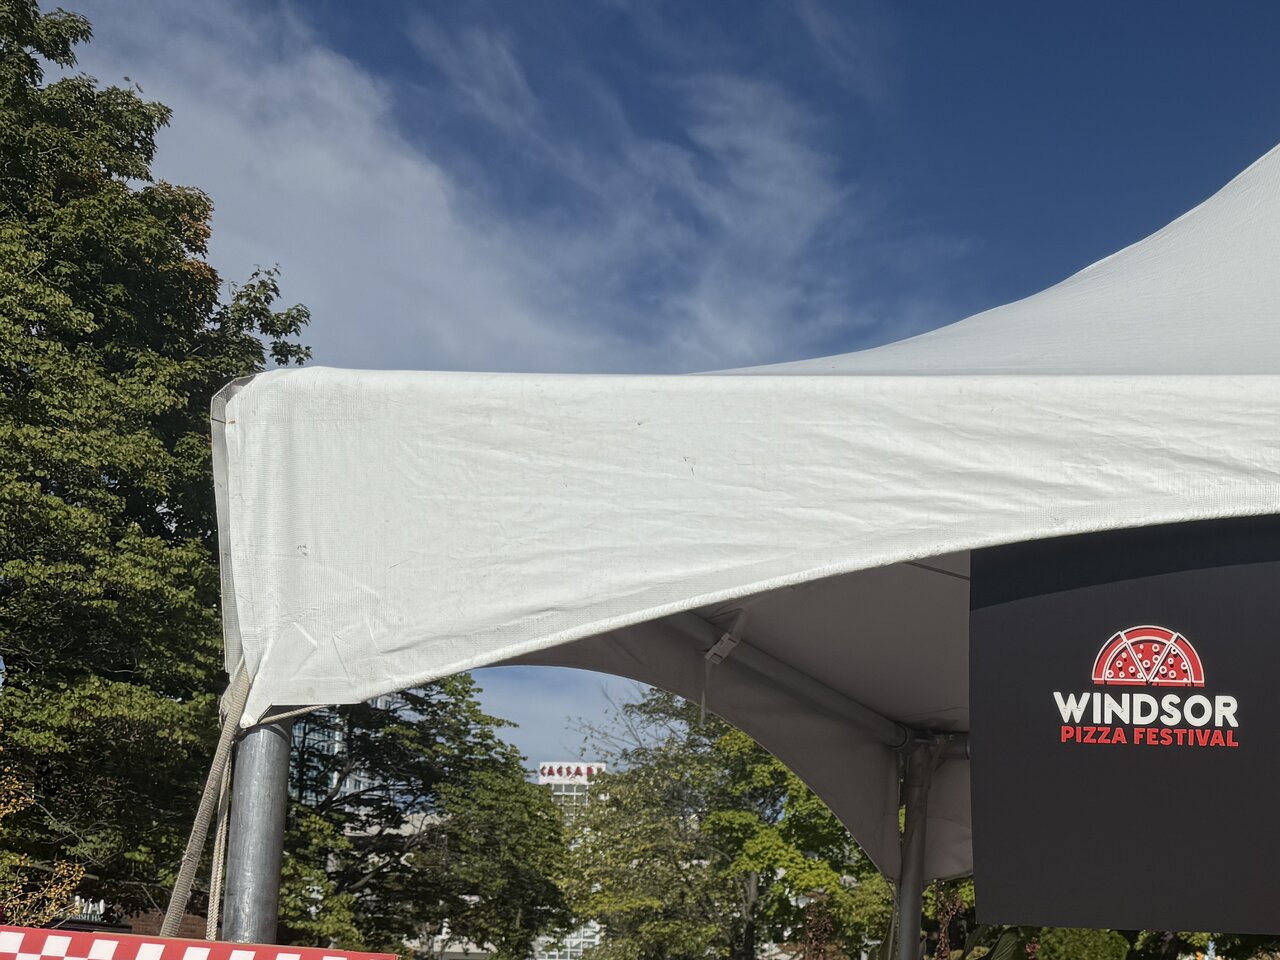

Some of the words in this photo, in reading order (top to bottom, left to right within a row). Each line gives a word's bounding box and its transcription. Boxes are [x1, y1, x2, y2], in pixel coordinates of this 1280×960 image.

[1053, 691, 1239, 728] WINDSOR
[1060, 725, 1127, 745] PIZZA
[1134, 728, 1239, 747] FESTIVAL
